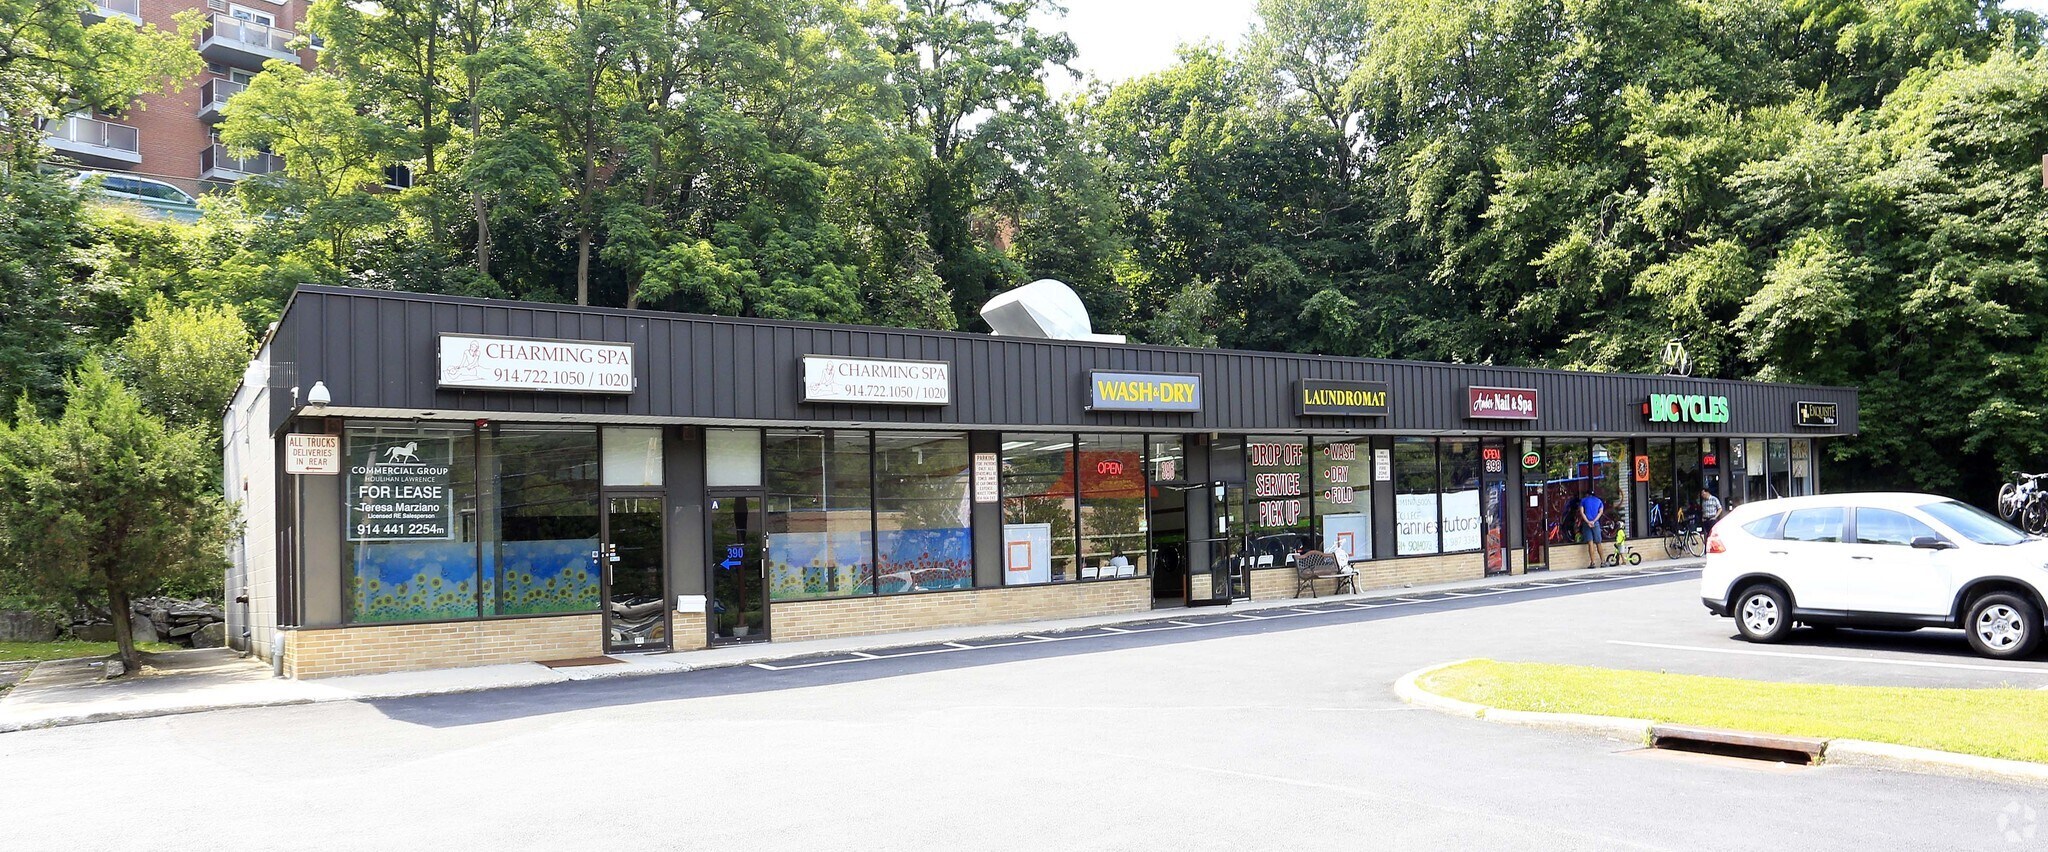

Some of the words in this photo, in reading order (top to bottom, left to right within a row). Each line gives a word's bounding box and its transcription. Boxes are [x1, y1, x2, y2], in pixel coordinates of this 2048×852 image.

[486, 343, 593, 364] CHARMING
[597, 350, 629, 365] SPA
[494, 368, 585, 385] 914.722.1050
[588, 371, 594, 387] /
[599, 373, 629, 387] 1020
[839, 362, 919, 380] CHARMING
[922, 367, 946, 380] SPA
[845, 384, 913, 398] 914.722.1050
[915, 386, 920, 399] /
[923, 387, 946, 399] 1020
[1304, 389, 1386, 407] LAUNDROMAT
[1494, 393, 1510, 410] Nail
[1511, 396, 1517, 410] &
[1517, 394, 1533, 415] Spa
[1649, 393, 1729, 424] BICYCLES
[289, 437, 303, 447] ALL
[307, 437, 336, 448] TRUCKS
[293, 448, 332, 457] DELIVERIES
[1252, 443, 1281, 466] DROP
[1283, 443, 1303, 466] OFF
[1330, 443, 1356, 460] WASH
[1483, 448, 1500, 460] OPEN
[309, 458, 328, 466] REAR
[1486, 459, 1502, 472] 398
[1524, 455, 1538, 465] OPEN
[351, 466, 414, 475] COMMERCIAL
[417, 467, 448, 475] GROUP
[1097, 462, 1123, 475] OPEN
[1330, 465, 1349, 483] DRY
[359, 485, 390, 499] FOR
[395, 485, 442, 499] LEASE
[1256, 473, 1300, 497] SERVICE
[1331, 487, 1354, 503] FOLD
[359, 502, 393, 512] Teresa
[395, 502, 440, 512] Marziano
[711, 501, 719, 510] A
[1260, 500, 1284, 527] PICK
[1286, 500, 1300, 526] UP
[357, 524, 380, 535] 914
[383, 524, 404, 535] 441
[408, 524, 444, 535] 2254m
[1443, 515, 1478, 533] tutors
[727, 547, 744, 559] 390
